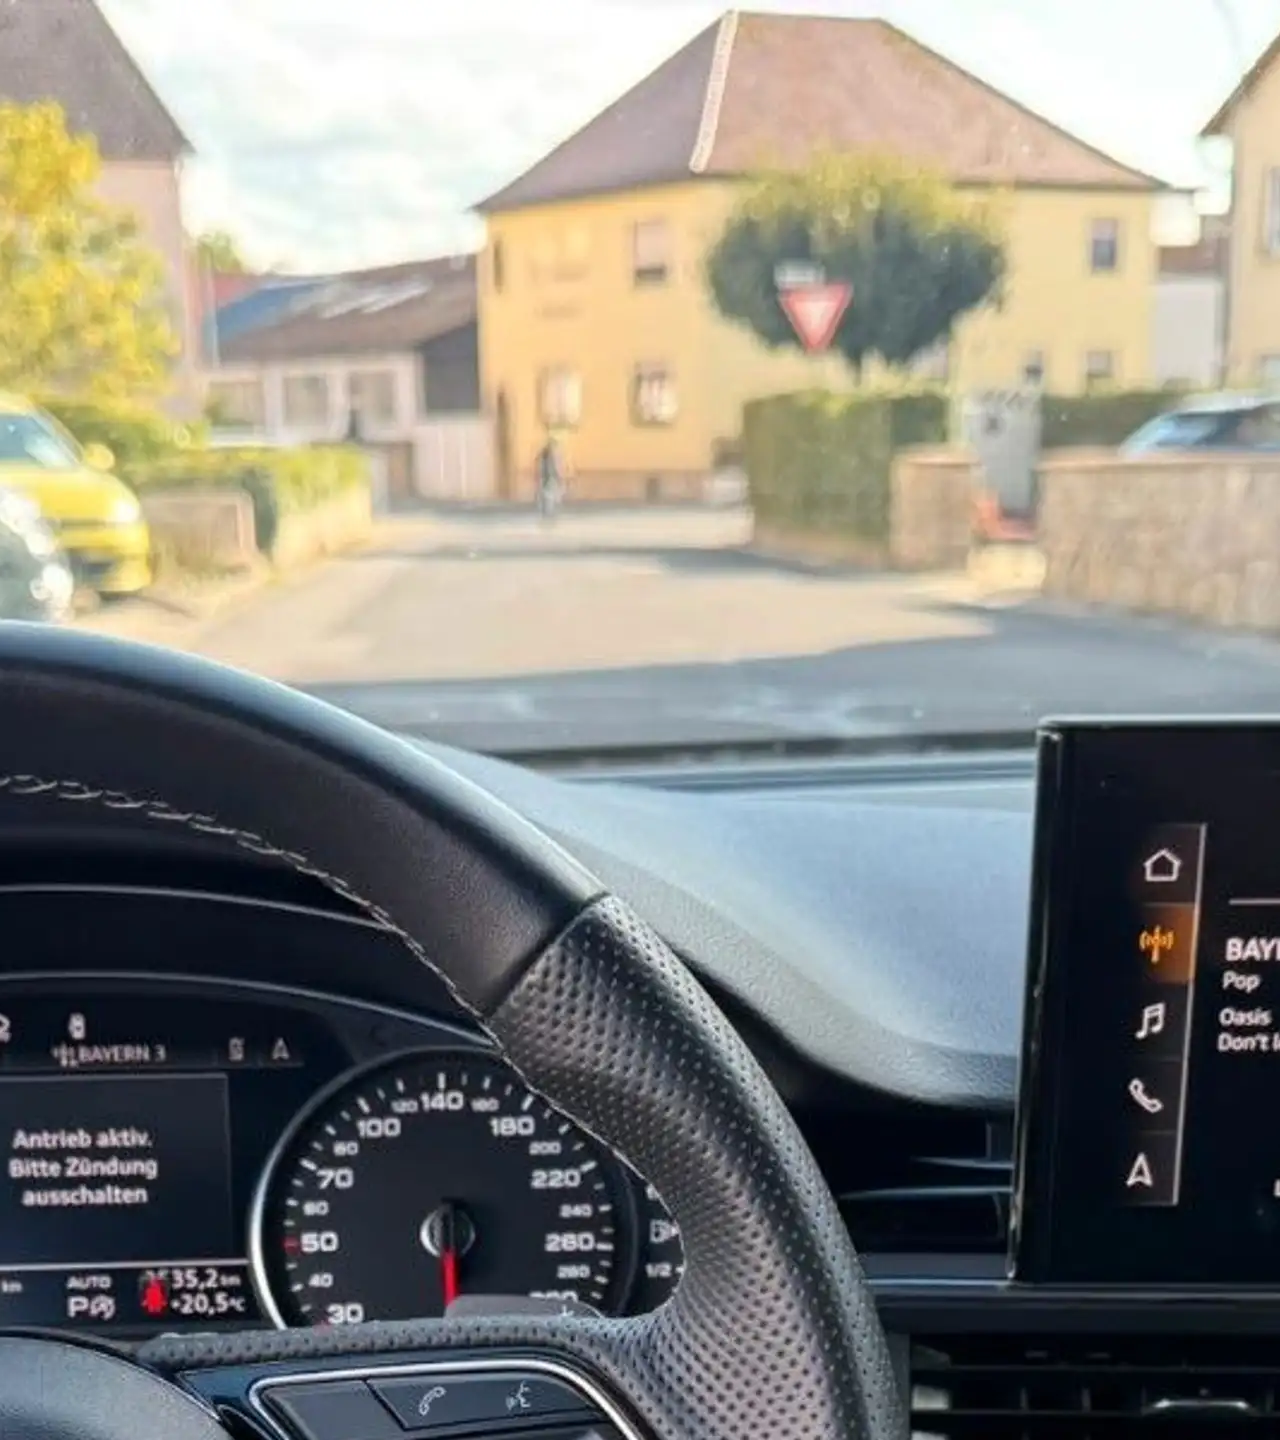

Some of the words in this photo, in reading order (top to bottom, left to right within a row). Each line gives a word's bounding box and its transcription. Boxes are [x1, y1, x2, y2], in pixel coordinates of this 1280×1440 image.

[1222, 971, 1261, 993] Pop
[1219, 1007, 1272, 1026] Oasis
[1218, 1032, 1269, 1052] Don't
[79, 1044, 150, 1063] BAYERN
[155, 1045, 167, 1062] 3
[421, 1090, 464, 1111] 140
[356, 1117, 402, 1138] 100
[489, 1116, 535, 1137] 180
[13, 1129, 91, 1149] Antrieb
[96, 1128, 152, 1148] aktiv.
[9, 1158, 62, 1178] Bitte
[64, 1156, 158, 1180] Zündung
[317, 1167, 354, 1189] 70
[530, 1168, 581, 1189] 220
[22, 1185, 148, 1206] ausschalten
[300, 1231, 339, 1253] 50
[544, 1233, 596, 1252] 260
[67, 1275, 112, 1290] AUTO
[308, 1272, 334, 1288] 40
[327, 1303, 365, 1323] 30
